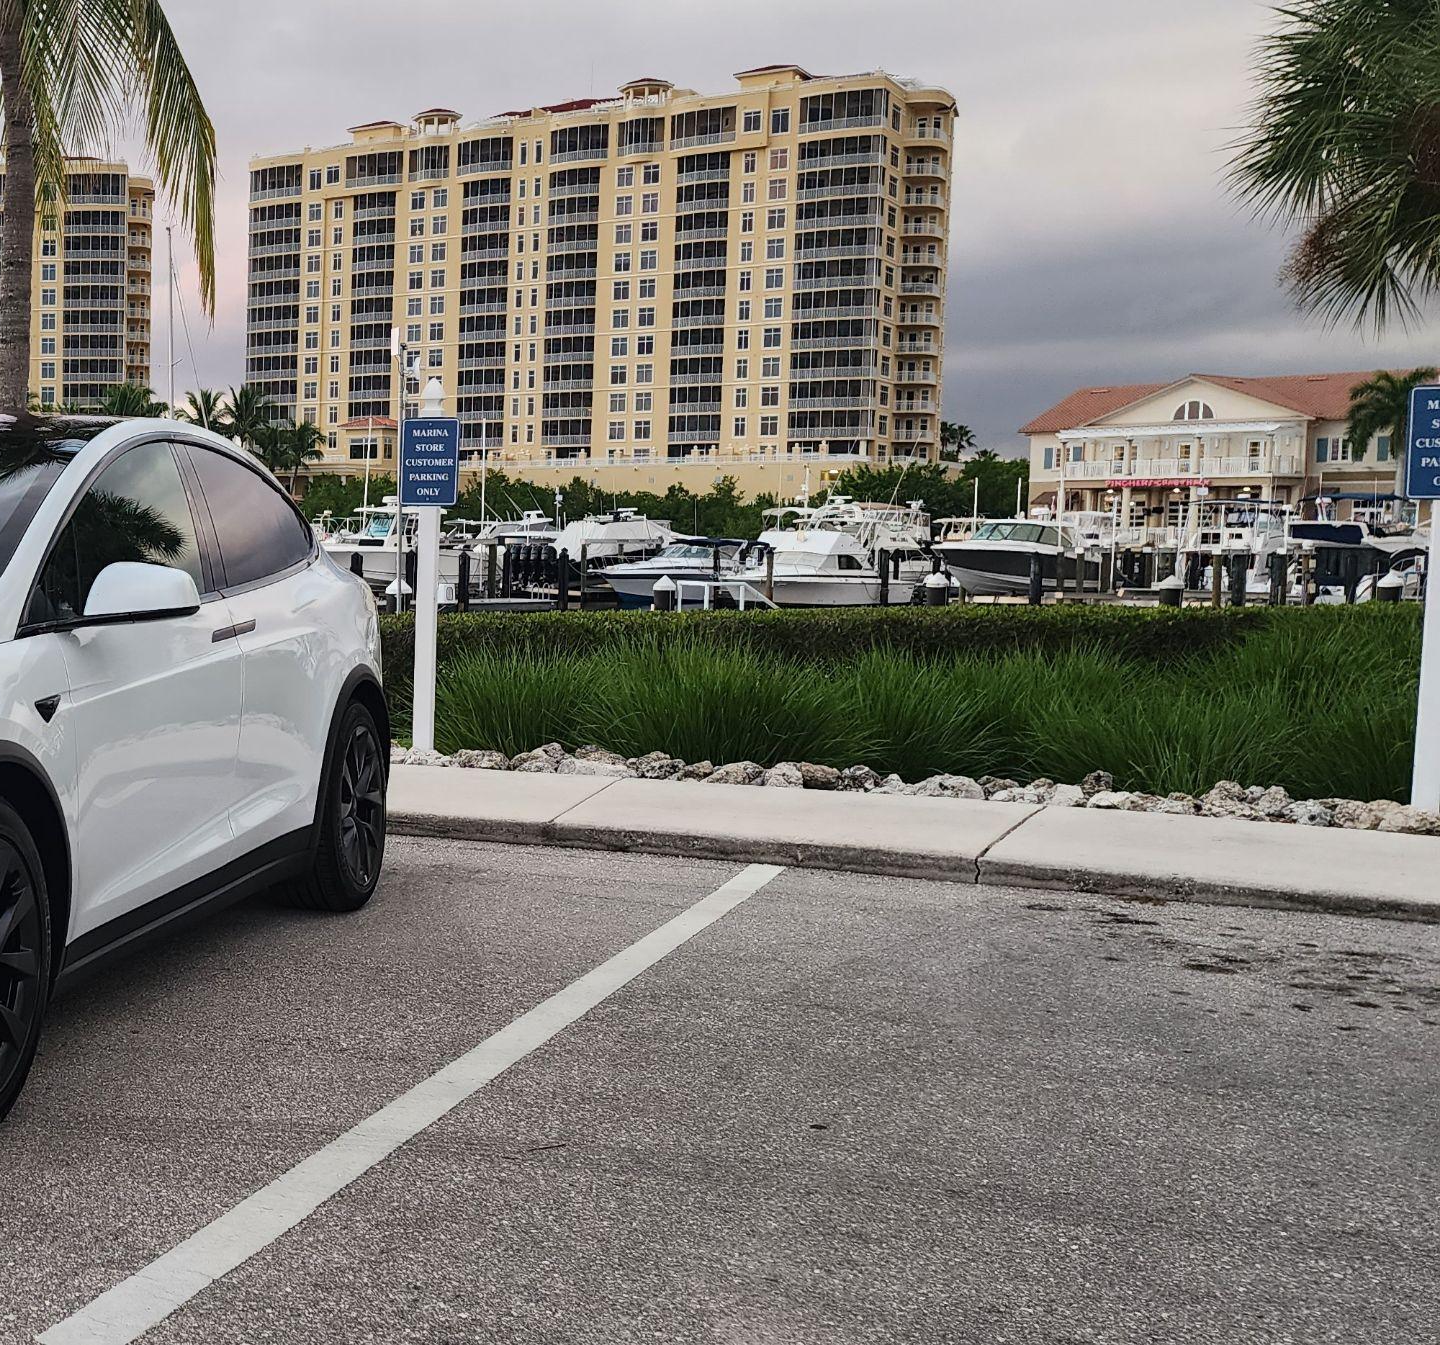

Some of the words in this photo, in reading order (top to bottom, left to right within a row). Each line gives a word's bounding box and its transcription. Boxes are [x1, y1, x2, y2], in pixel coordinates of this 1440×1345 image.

[412, 429, 449, 437] MARINA
[415, 443, 445, 452] STORE
[405, 458, 454, 467] CUSTOMER
[409, 473, 449, 481] PARKING
[416, 487, 441, 496] ONLY
